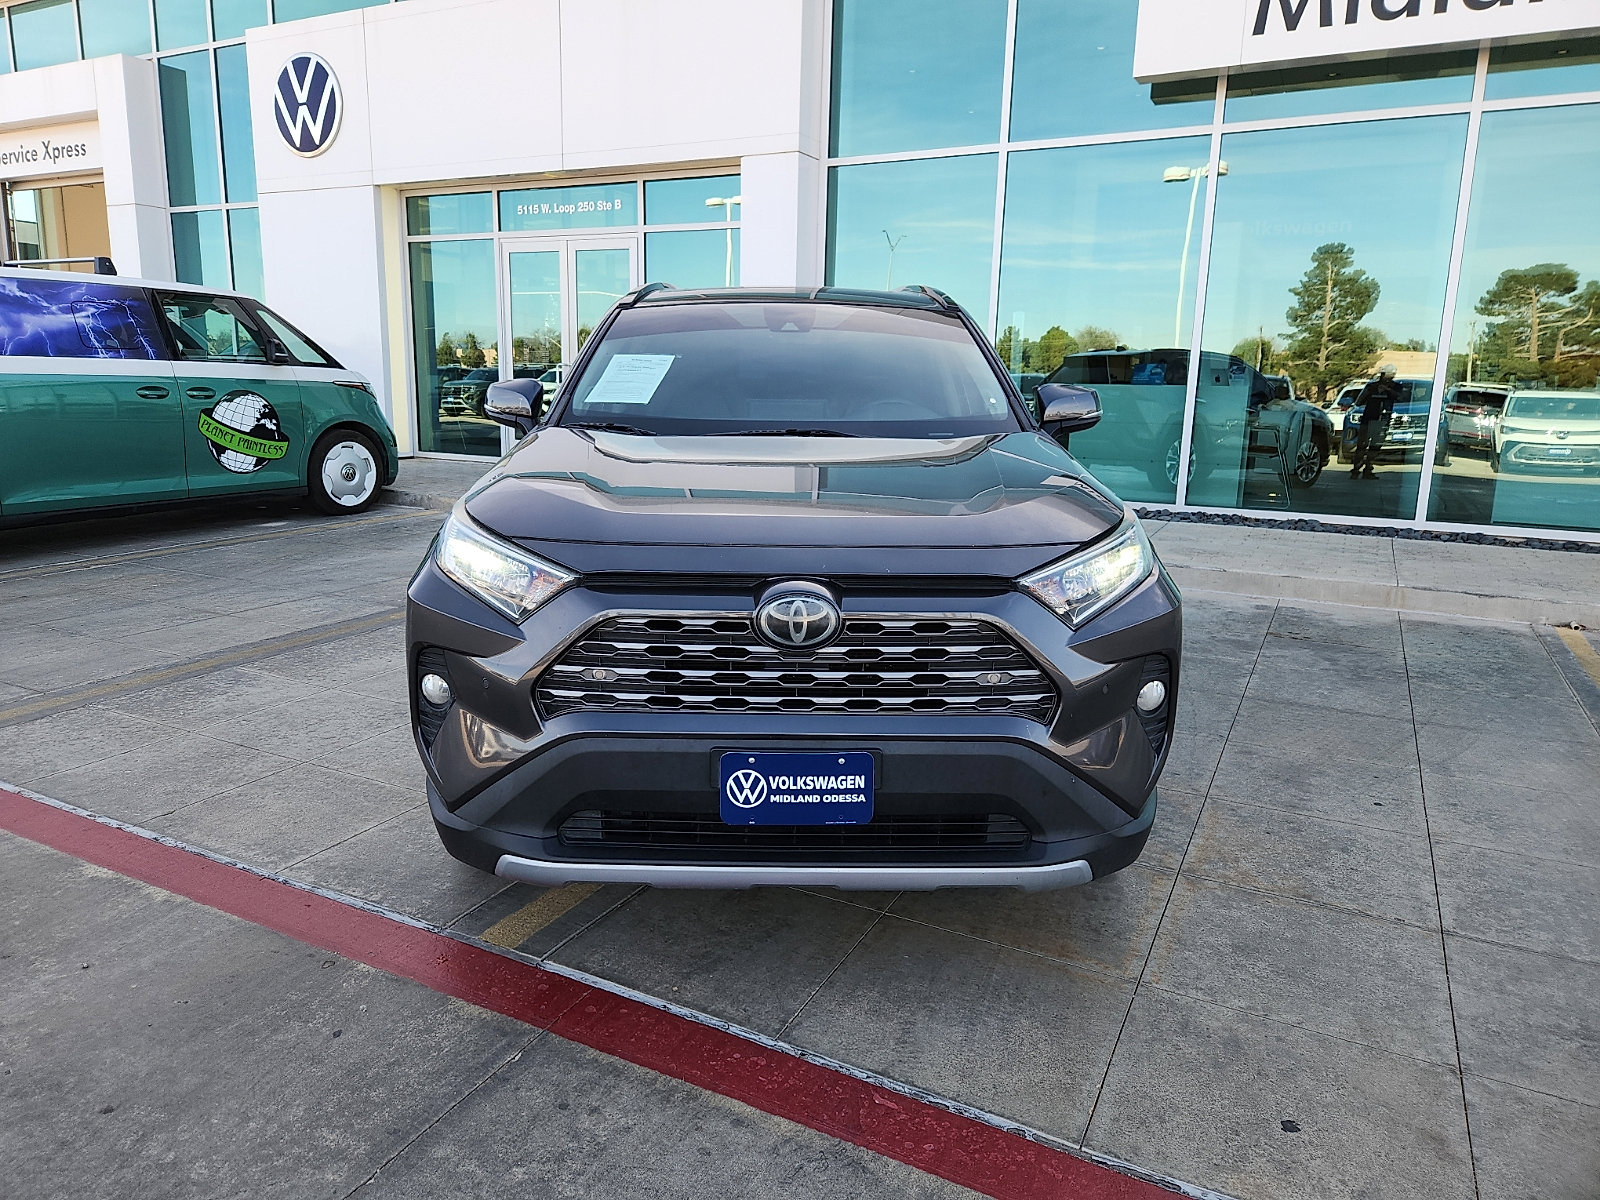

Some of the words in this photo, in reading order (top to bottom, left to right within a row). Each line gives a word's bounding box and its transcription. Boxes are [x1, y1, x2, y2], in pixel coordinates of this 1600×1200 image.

[0, 145, 38, 165] ervice
[41, 139, 87, 165] Xpress
[517, 204, 539, 215] 5115
[541, 203, 552, 214] W.
[553, 202, 576, 214] Loop
[577, 201, 595, 212] 250
[597, 200, 613, 211] Ste
[614, 199, 622, 210] B
[200, 418, 236, 445] PLANET
[237, 436, 285, 457] PAINTLESS
[768, 774, 866, 791] VOLKSWAGEN
[769, 794, 821, 804] MIDLAND
[822, 793, 867, 804] ODESSA
